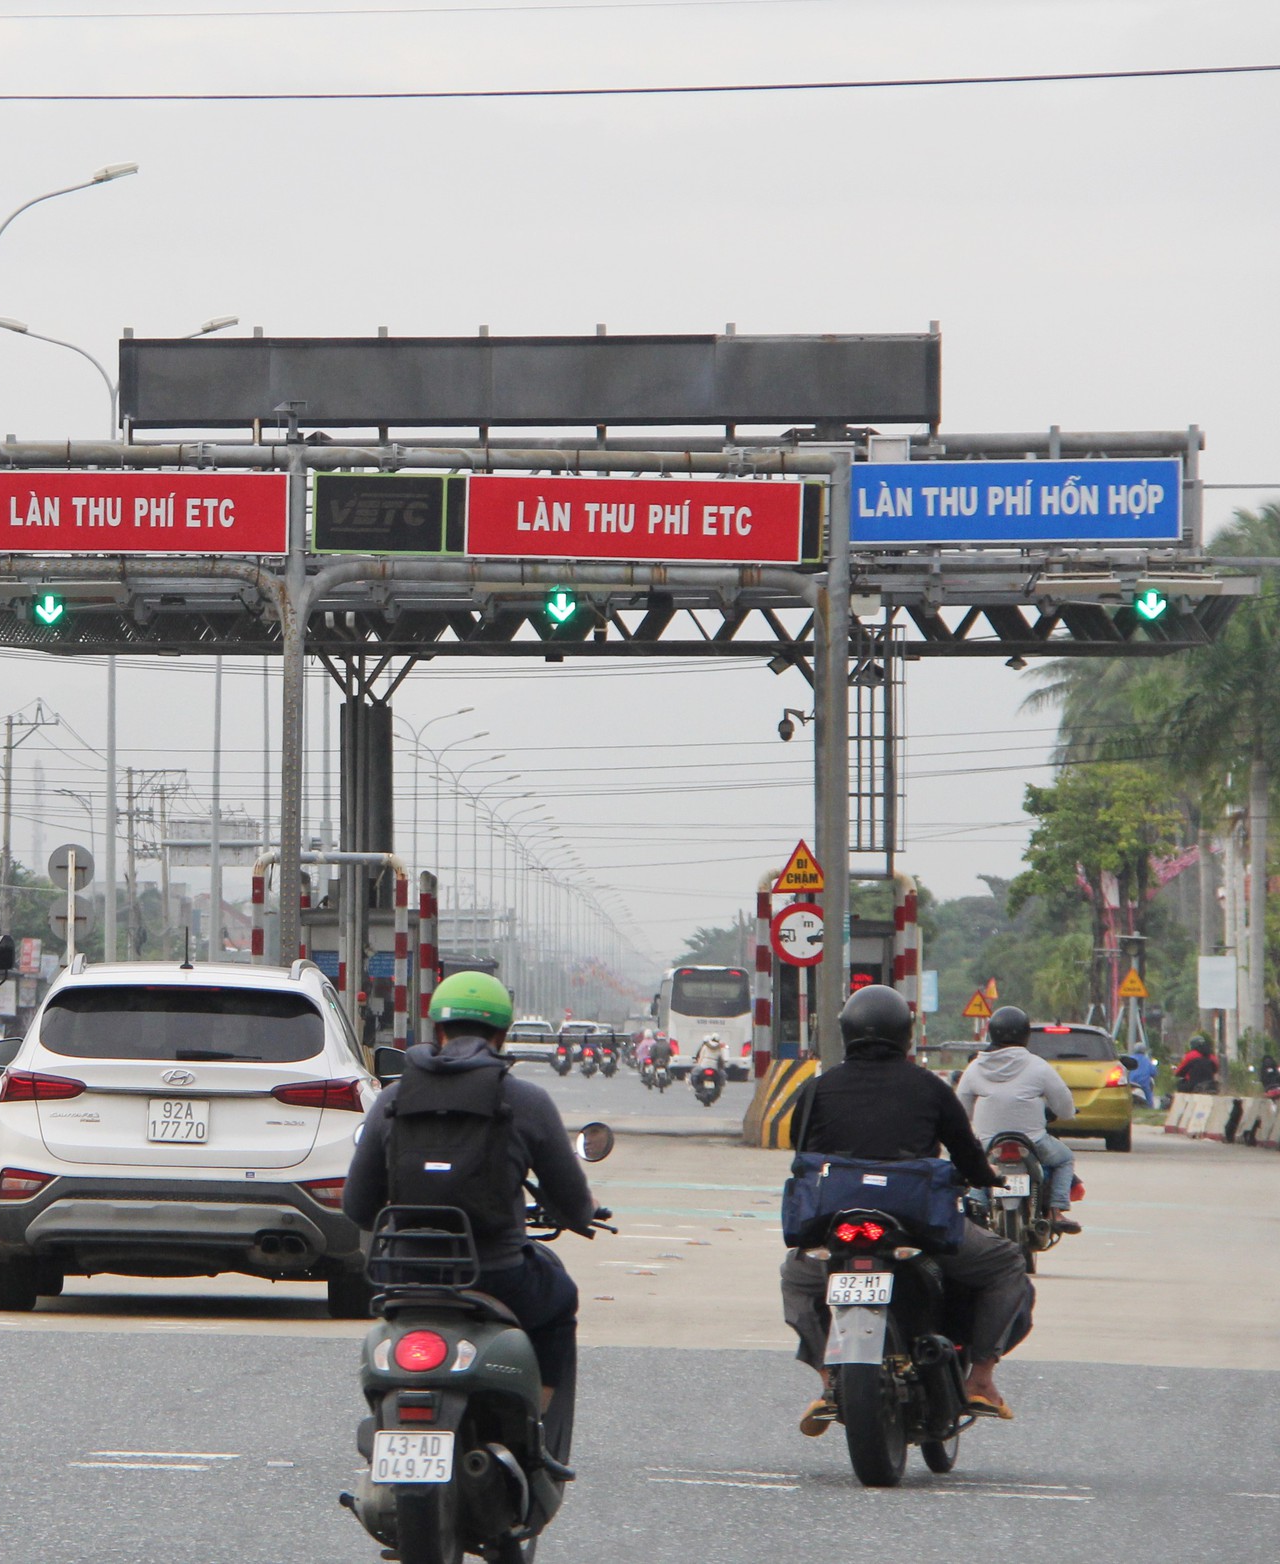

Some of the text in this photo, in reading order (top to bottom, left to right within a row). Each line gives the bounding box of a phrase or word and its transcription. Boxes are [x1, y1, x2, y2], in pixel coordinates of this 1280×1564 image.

[858, 475, 1164, 519] LÀN THU PHÍ HỖN HỢP
[9, 490, 235, 528] LÀN THU PHÍ ETC
[517, 496, 752, 536] LÀN THU PHÍ ETC
[162, 1102, 193, 1120] 92A
[150, 1121, 206, 1139] 177.70
[839, 1276, 880, 1289] 92-H1
[832, 1289, 887, 1302] 583.30
[387, 1437, 441, 1455] 43-AD
[378, 1459, 446, 1478] 049.75
